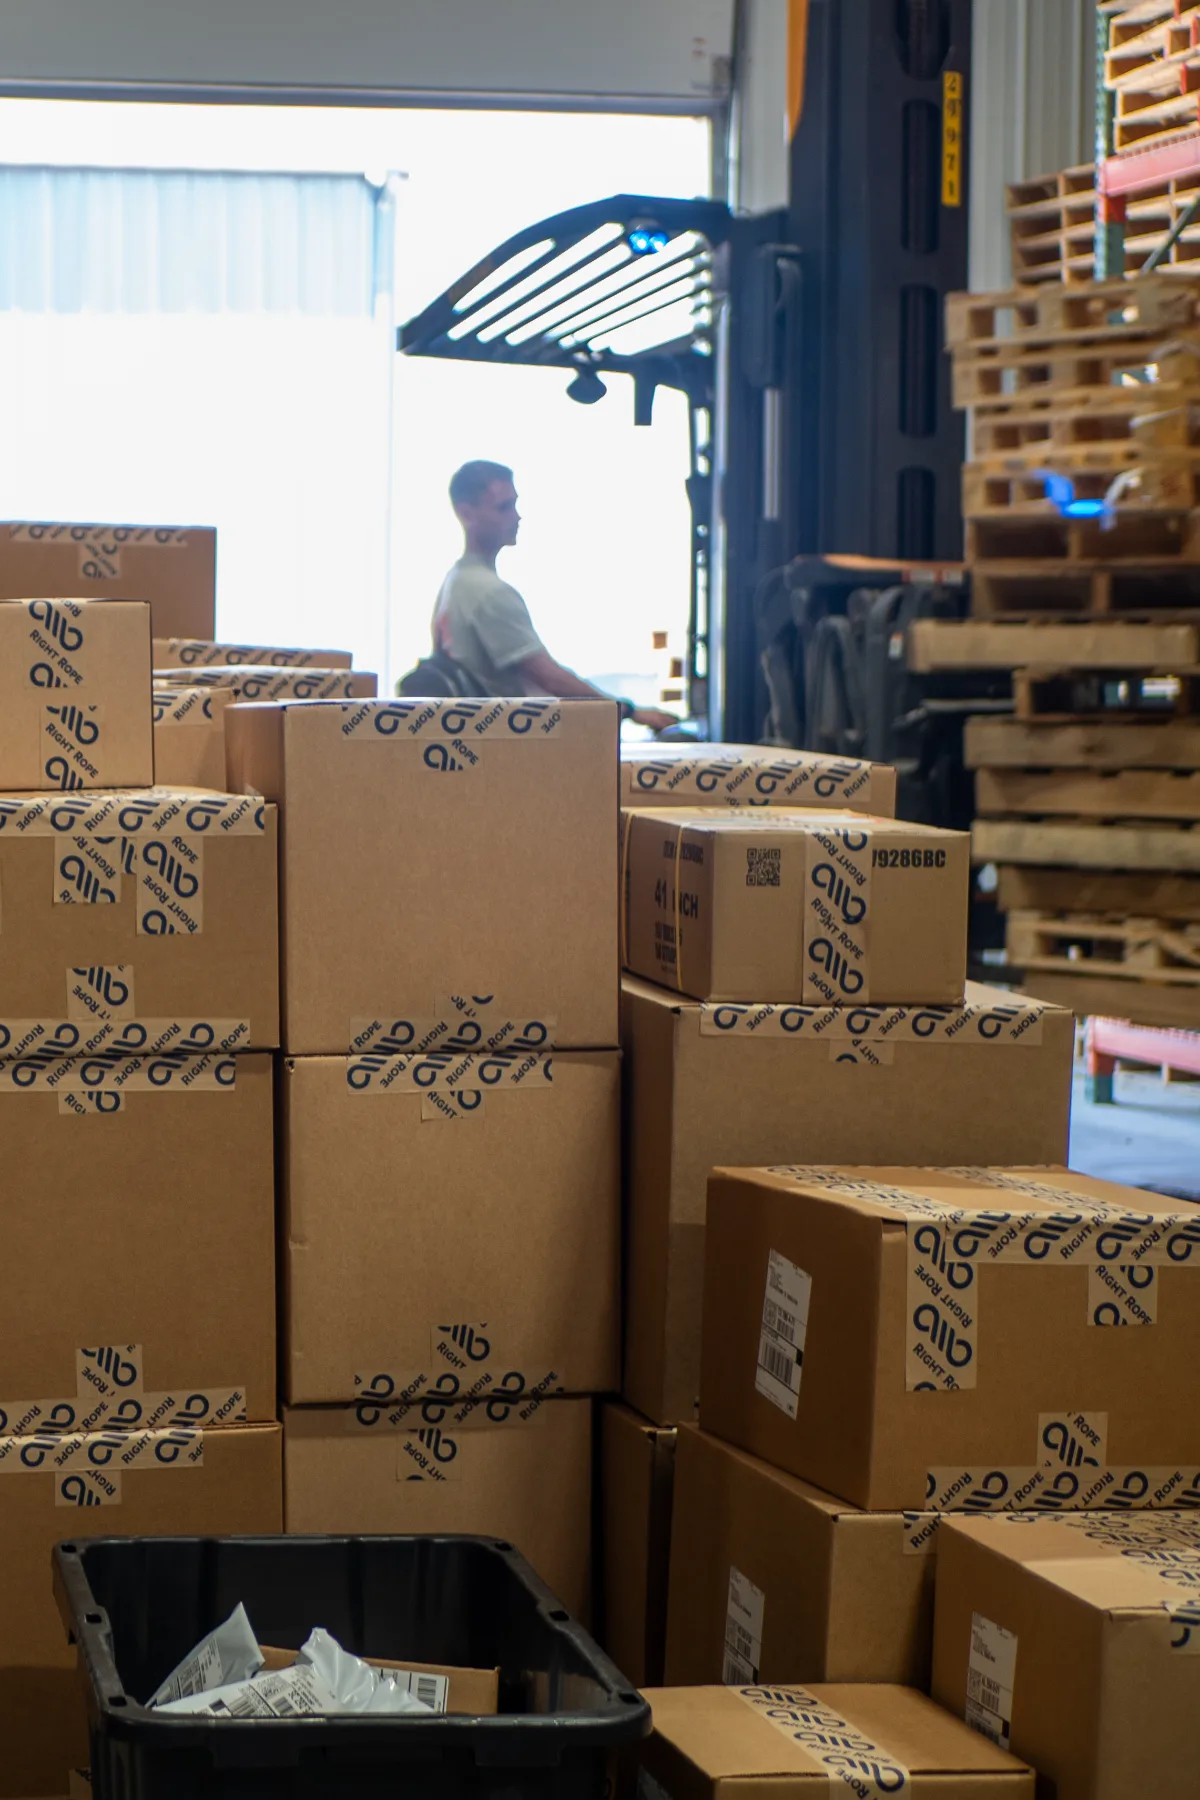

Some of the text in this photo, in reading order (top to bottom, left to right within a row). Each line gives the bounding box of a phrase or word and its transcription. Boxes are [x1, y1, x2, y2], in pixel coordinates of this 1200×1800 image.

[29, 629, 84, 685] RIGHT ROPE
[173, 692, 199, 720] RIGHT
[341, 704, 371, 735] RIGHT
[474, 704, 504, 734] RIGHT
[408, 708, 435, 735] ROPE
[541, 711, 560, 734] OPE
[45, 722, 99, 778] RIGHT ROPE
[452, 739, 479, 765] ROPE
[667, 767, 691, 790] ROPE
[726, 767, 753, 793] RIGHT
[784, 772, 809, 795] ROPE
[843, 772, 871, 799] RIGHT
[18, 805, 43, 831] ROPE
[84, 803, 115, 831] RIGHT
[152, 804, 180, 831] ROPE
[220, 801, 251, 831] RIGHT
[85, 847, 116, 880] RIGHT
[171, 835, 199, 864] ROPE
[836, 854, 866, 886] RIGHT
[142, 874, 198, 933] RIGHT ROPE
[838, 932, 864, 960] ROPE
[72, 984, 99, 1013] ROPE
[808, 972, 835, 1000] ROPE
[746, 1006, 774, 1031] ROPE
[879, 1007, 906, 1035] ROPE
[944, 1007, 975, 1038] RIGHT
[1010, 1013, 1038, 1040] ROPE
[13, 1023, 45, 1055] RIGHT
[85, 1023, 114, 1051] ROPE
[151, 1023, 182, 1053] RIGHT
[220, 1023, 248, 1050] ROPE
[353, 1020, 382, 1047] ROPE
[418, 1021, 448, 1051] RIGHT
[487, 1021, 515, 1048] ROPE
[46, 1056, 77, 1086] RIGHT
[113, 1059, 142, 1086] ROPE
[180, 1053, 212, 1086] RIGHT
[380, 1060, 406, 1088] ROPE
[445, 1053, 475, 1086] RIGHT
[511, 1056, 537, 1083] ROPE
[427, 1091, 458, 1119] RIGHT
[987, 1227, 1018, 1258] ROPE
[1060, 1223, 1093, 1259] RIGHT
[1131, 1230, 1160, 1260] ROPE
[914, 1264, 972, 1328] RIGHT ROPE
[1095, 1264, 1152, 1324] RIGHT ROPE
[437, 1341, 467, 1369] RIGHT
[912, 1342, 945, 1377] RIGHT
[81, 1366, 108, 1394] ROPE
[400, 1373, 428, 1400] ROPE
[81, 1401, 109, 1429] ROPE
[146, 1396, 175, 1428] RIGHT
[215, 1391, 242, 1420] ROPE
[12, 1405, 41, 1436] RIGHT
[1073, 1415, 1100, 1446] ROPE
[53, 1439, 82, 1466] ROPE
[121, 1433, 152, 1464] RIGHT
[403, 1441, 429, 1468] ROPE
[938, 1471, 972, 1507] RIGHT
[1013, 1470, 1044, 1503] ROPE
[1080, 1471, 1114, 1506] RIGHT
[1154, 1470, 1184, 1502] ROPE
[835, 1767, 870, 1799] ROPE
